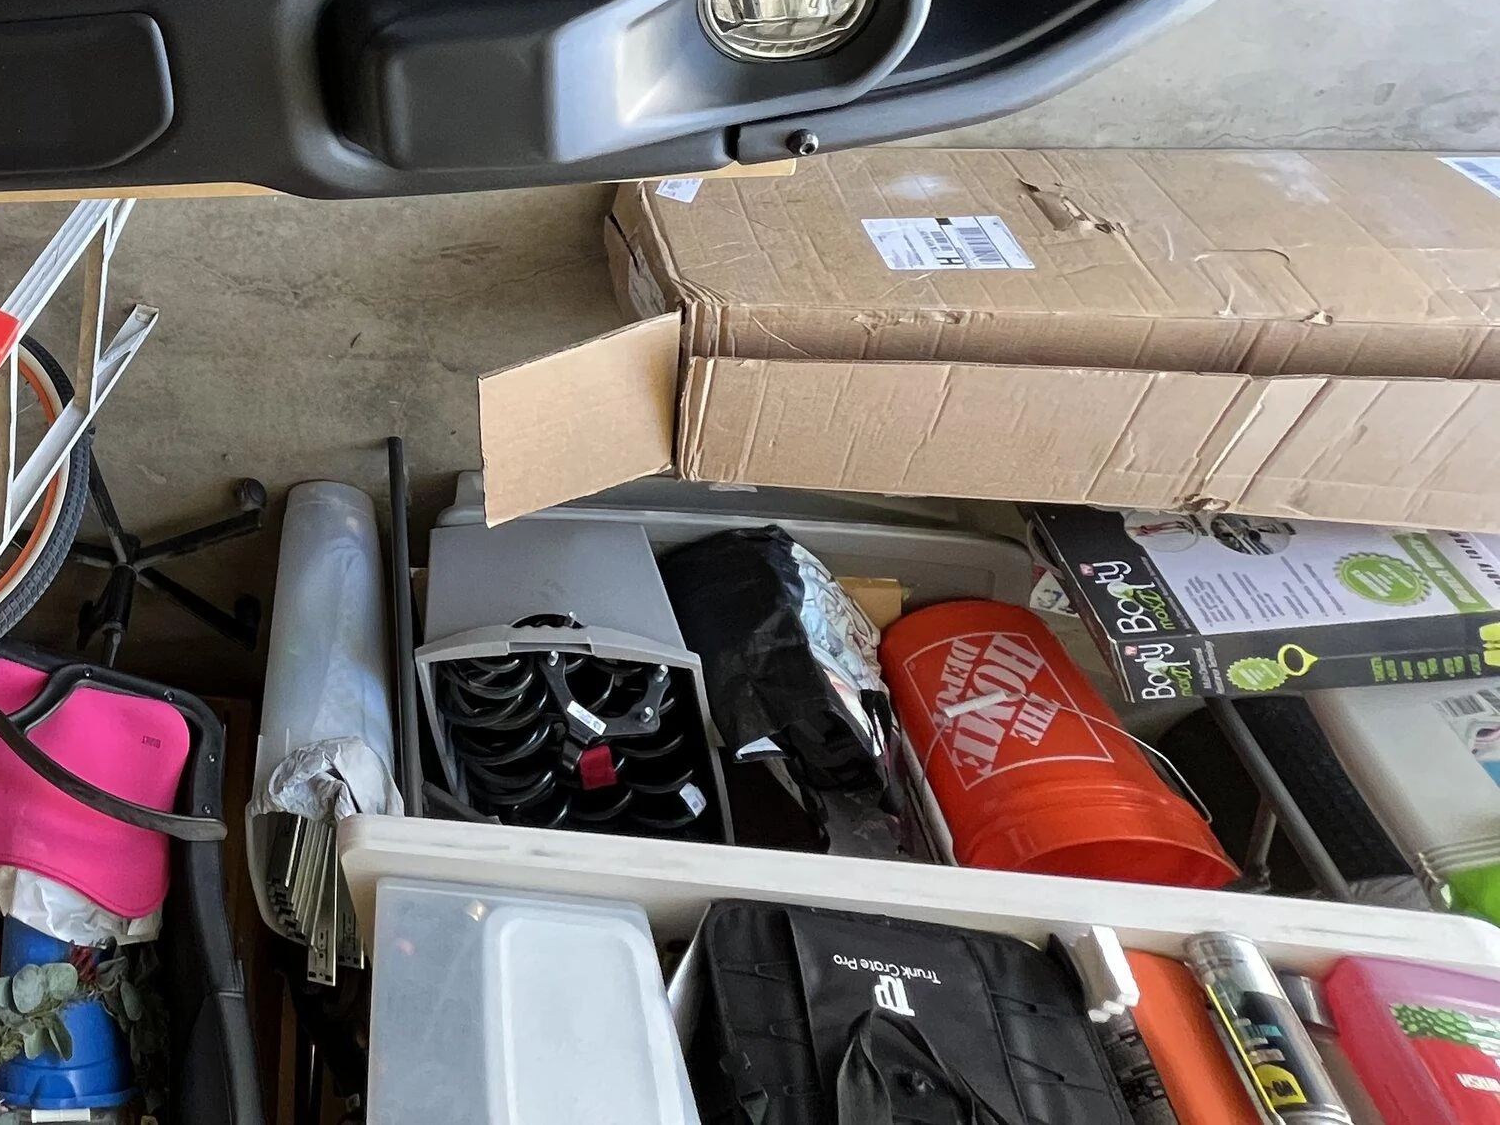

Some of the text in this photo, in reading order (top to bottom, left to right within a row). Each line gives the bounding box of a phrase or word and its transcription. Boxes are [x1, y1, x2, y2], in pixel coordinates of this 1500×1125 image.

[953, 631, 1044, 776] HOME
[1009, 692, 1060, 746] THE
[832, 954, 940, 983] Trunk Crate Pro
